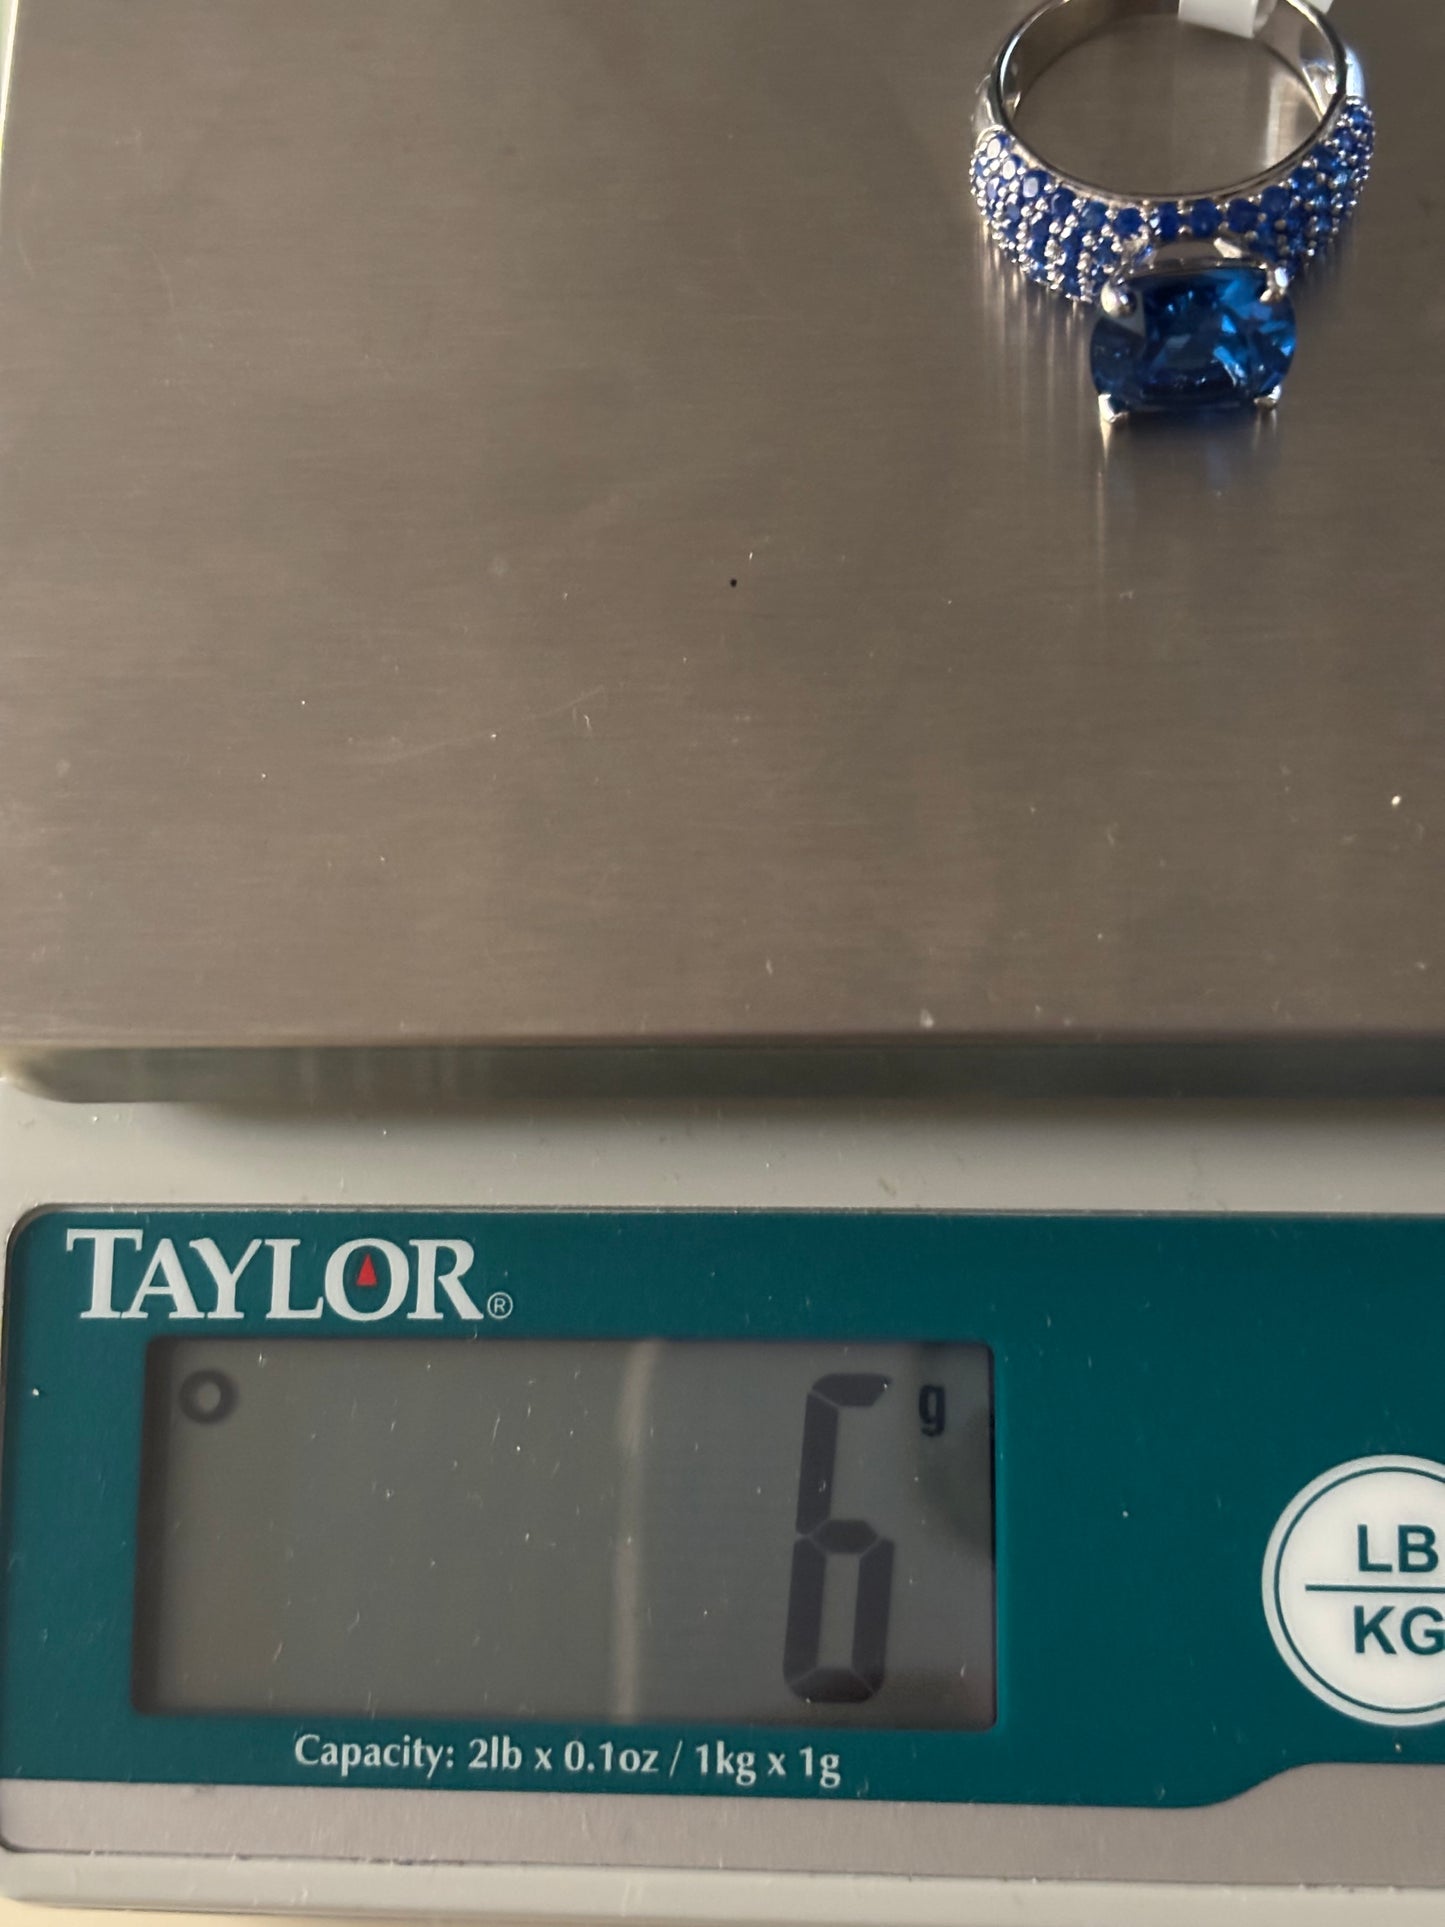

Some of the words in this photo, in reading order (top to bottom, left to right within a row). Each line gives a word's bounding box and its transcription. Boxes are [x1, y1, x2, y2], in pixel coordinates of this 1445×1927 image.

[783, 1373, 895, 1703] 6
[918, 1384, 946, 1437] g
[1357, 1524, 1438, 1573] LB
[1355, 1605, 1445, 1655] KG
[295, 1733, 454, 1779] Capacity:
[467, 1738, 522, 1770] 2lb
[534, 1748, 552, 1771] x
[564, 1741, 658, 1774] 0.1oz
[695, 1744, 757, 1785] 1kg
[767, 1753, 786, 1777] x
[799, 1746, 841, 1788] 1g
